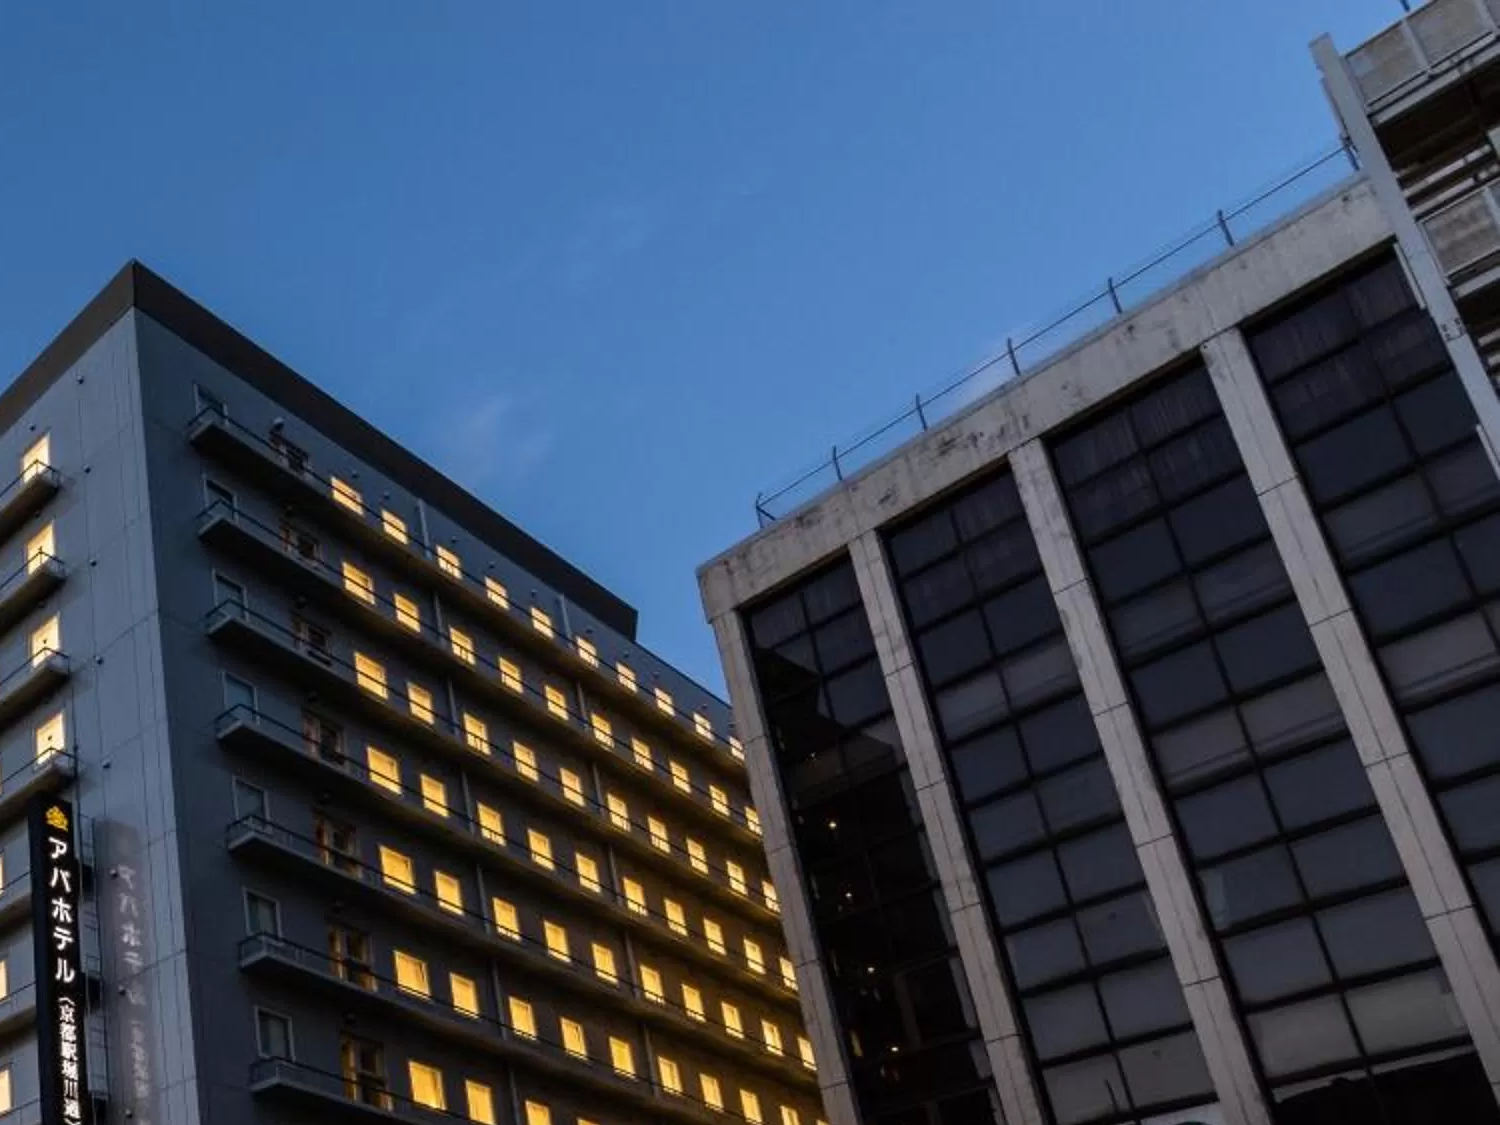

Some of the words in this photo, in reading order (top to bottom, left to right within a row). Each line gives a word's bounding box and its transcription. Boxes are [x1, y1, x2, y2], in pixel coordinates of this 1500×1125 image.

[48, 836, 76, 983] アパホテル
